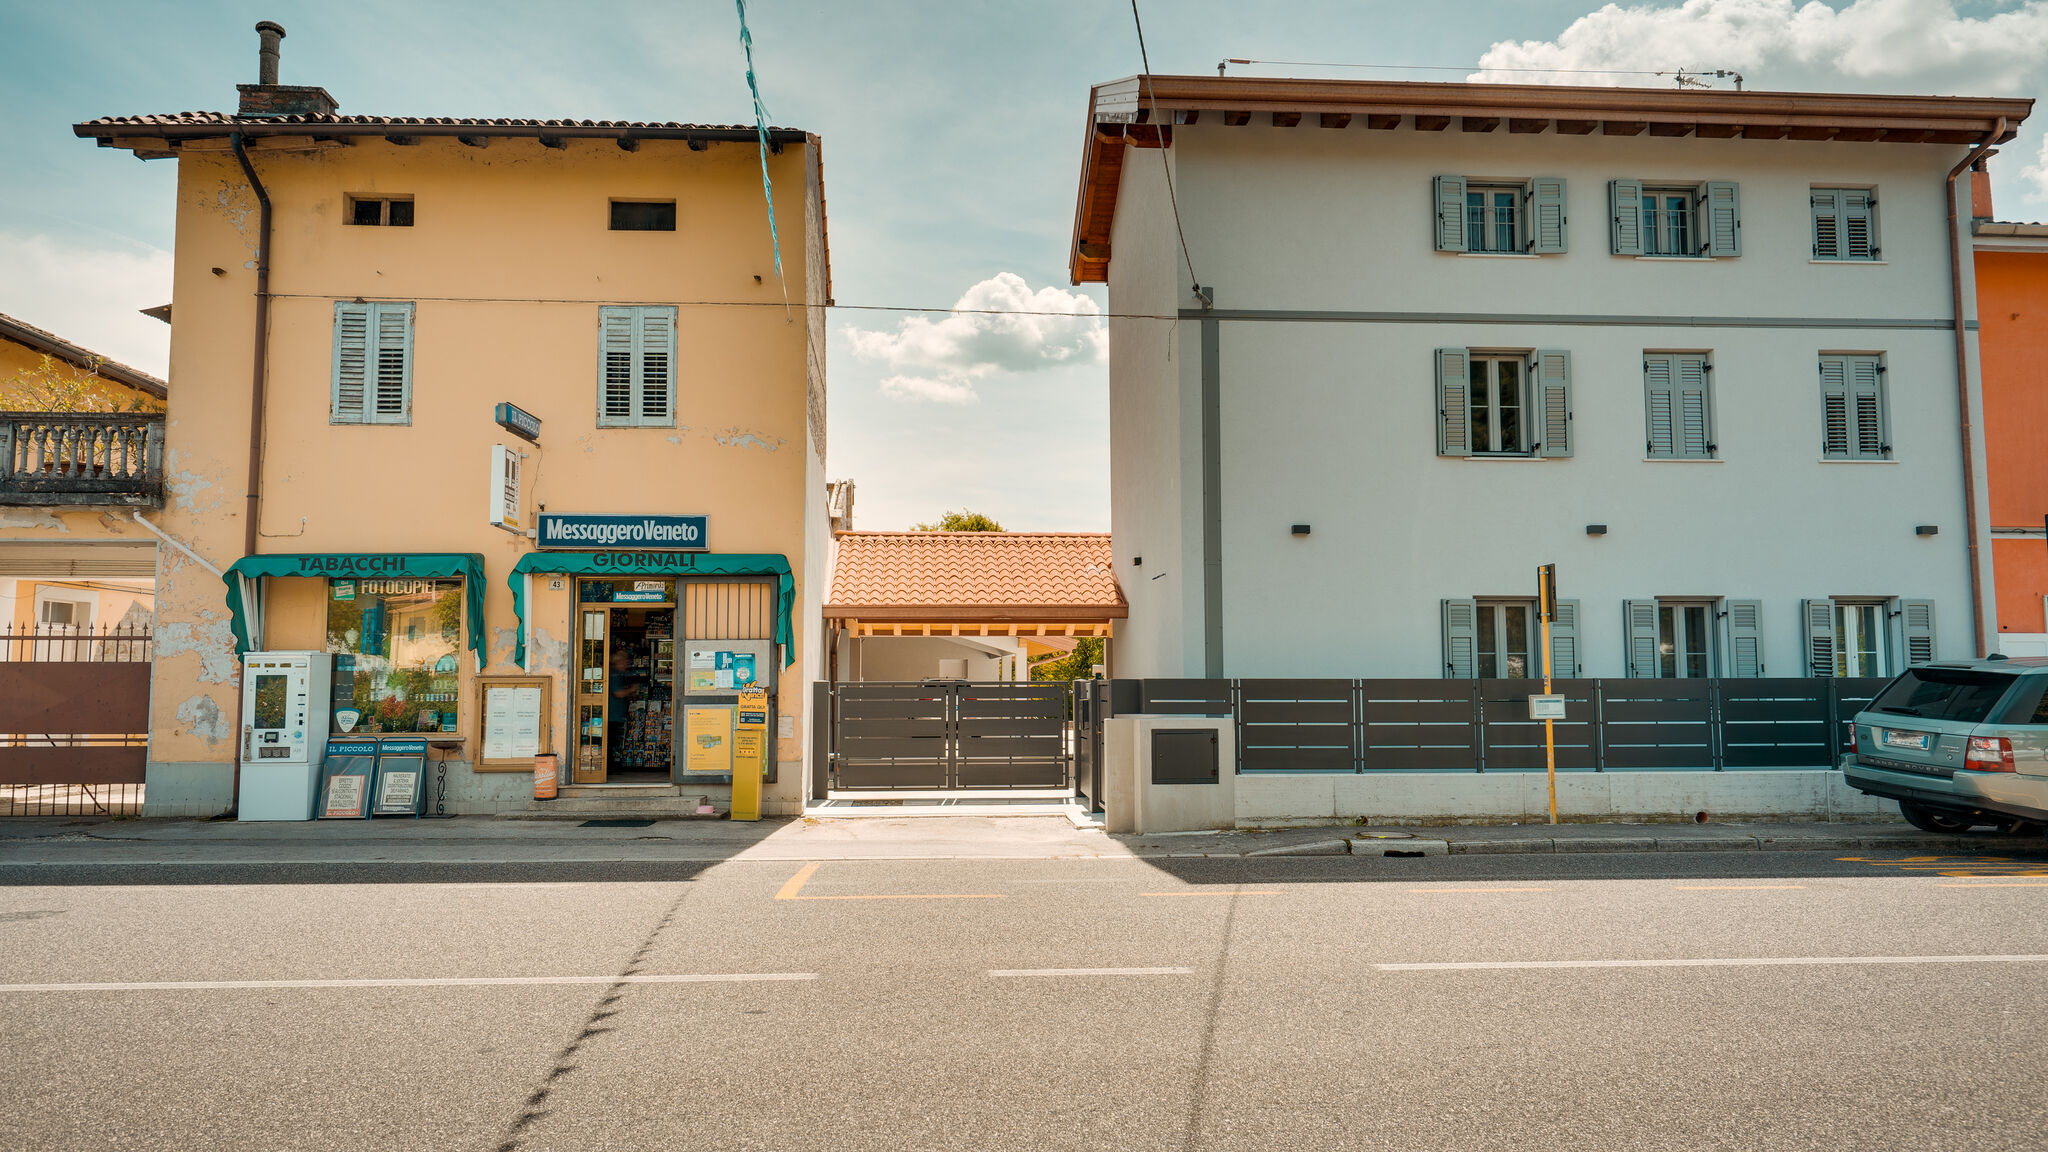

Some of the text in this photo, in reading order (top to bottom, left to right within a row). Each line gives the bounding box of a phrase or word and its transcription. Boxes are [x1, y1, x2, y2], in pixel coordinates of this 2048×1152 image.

[546, 518, 699, 544] MessaggeroVeneto
[299, 557, 406, 571] TABACCHI
[593, 553, 696, 567] GIORNALI
[361, 579, 433, 595] FOTOCOPIE
[616, 593, 663, 601] MessaggeroVeneto
